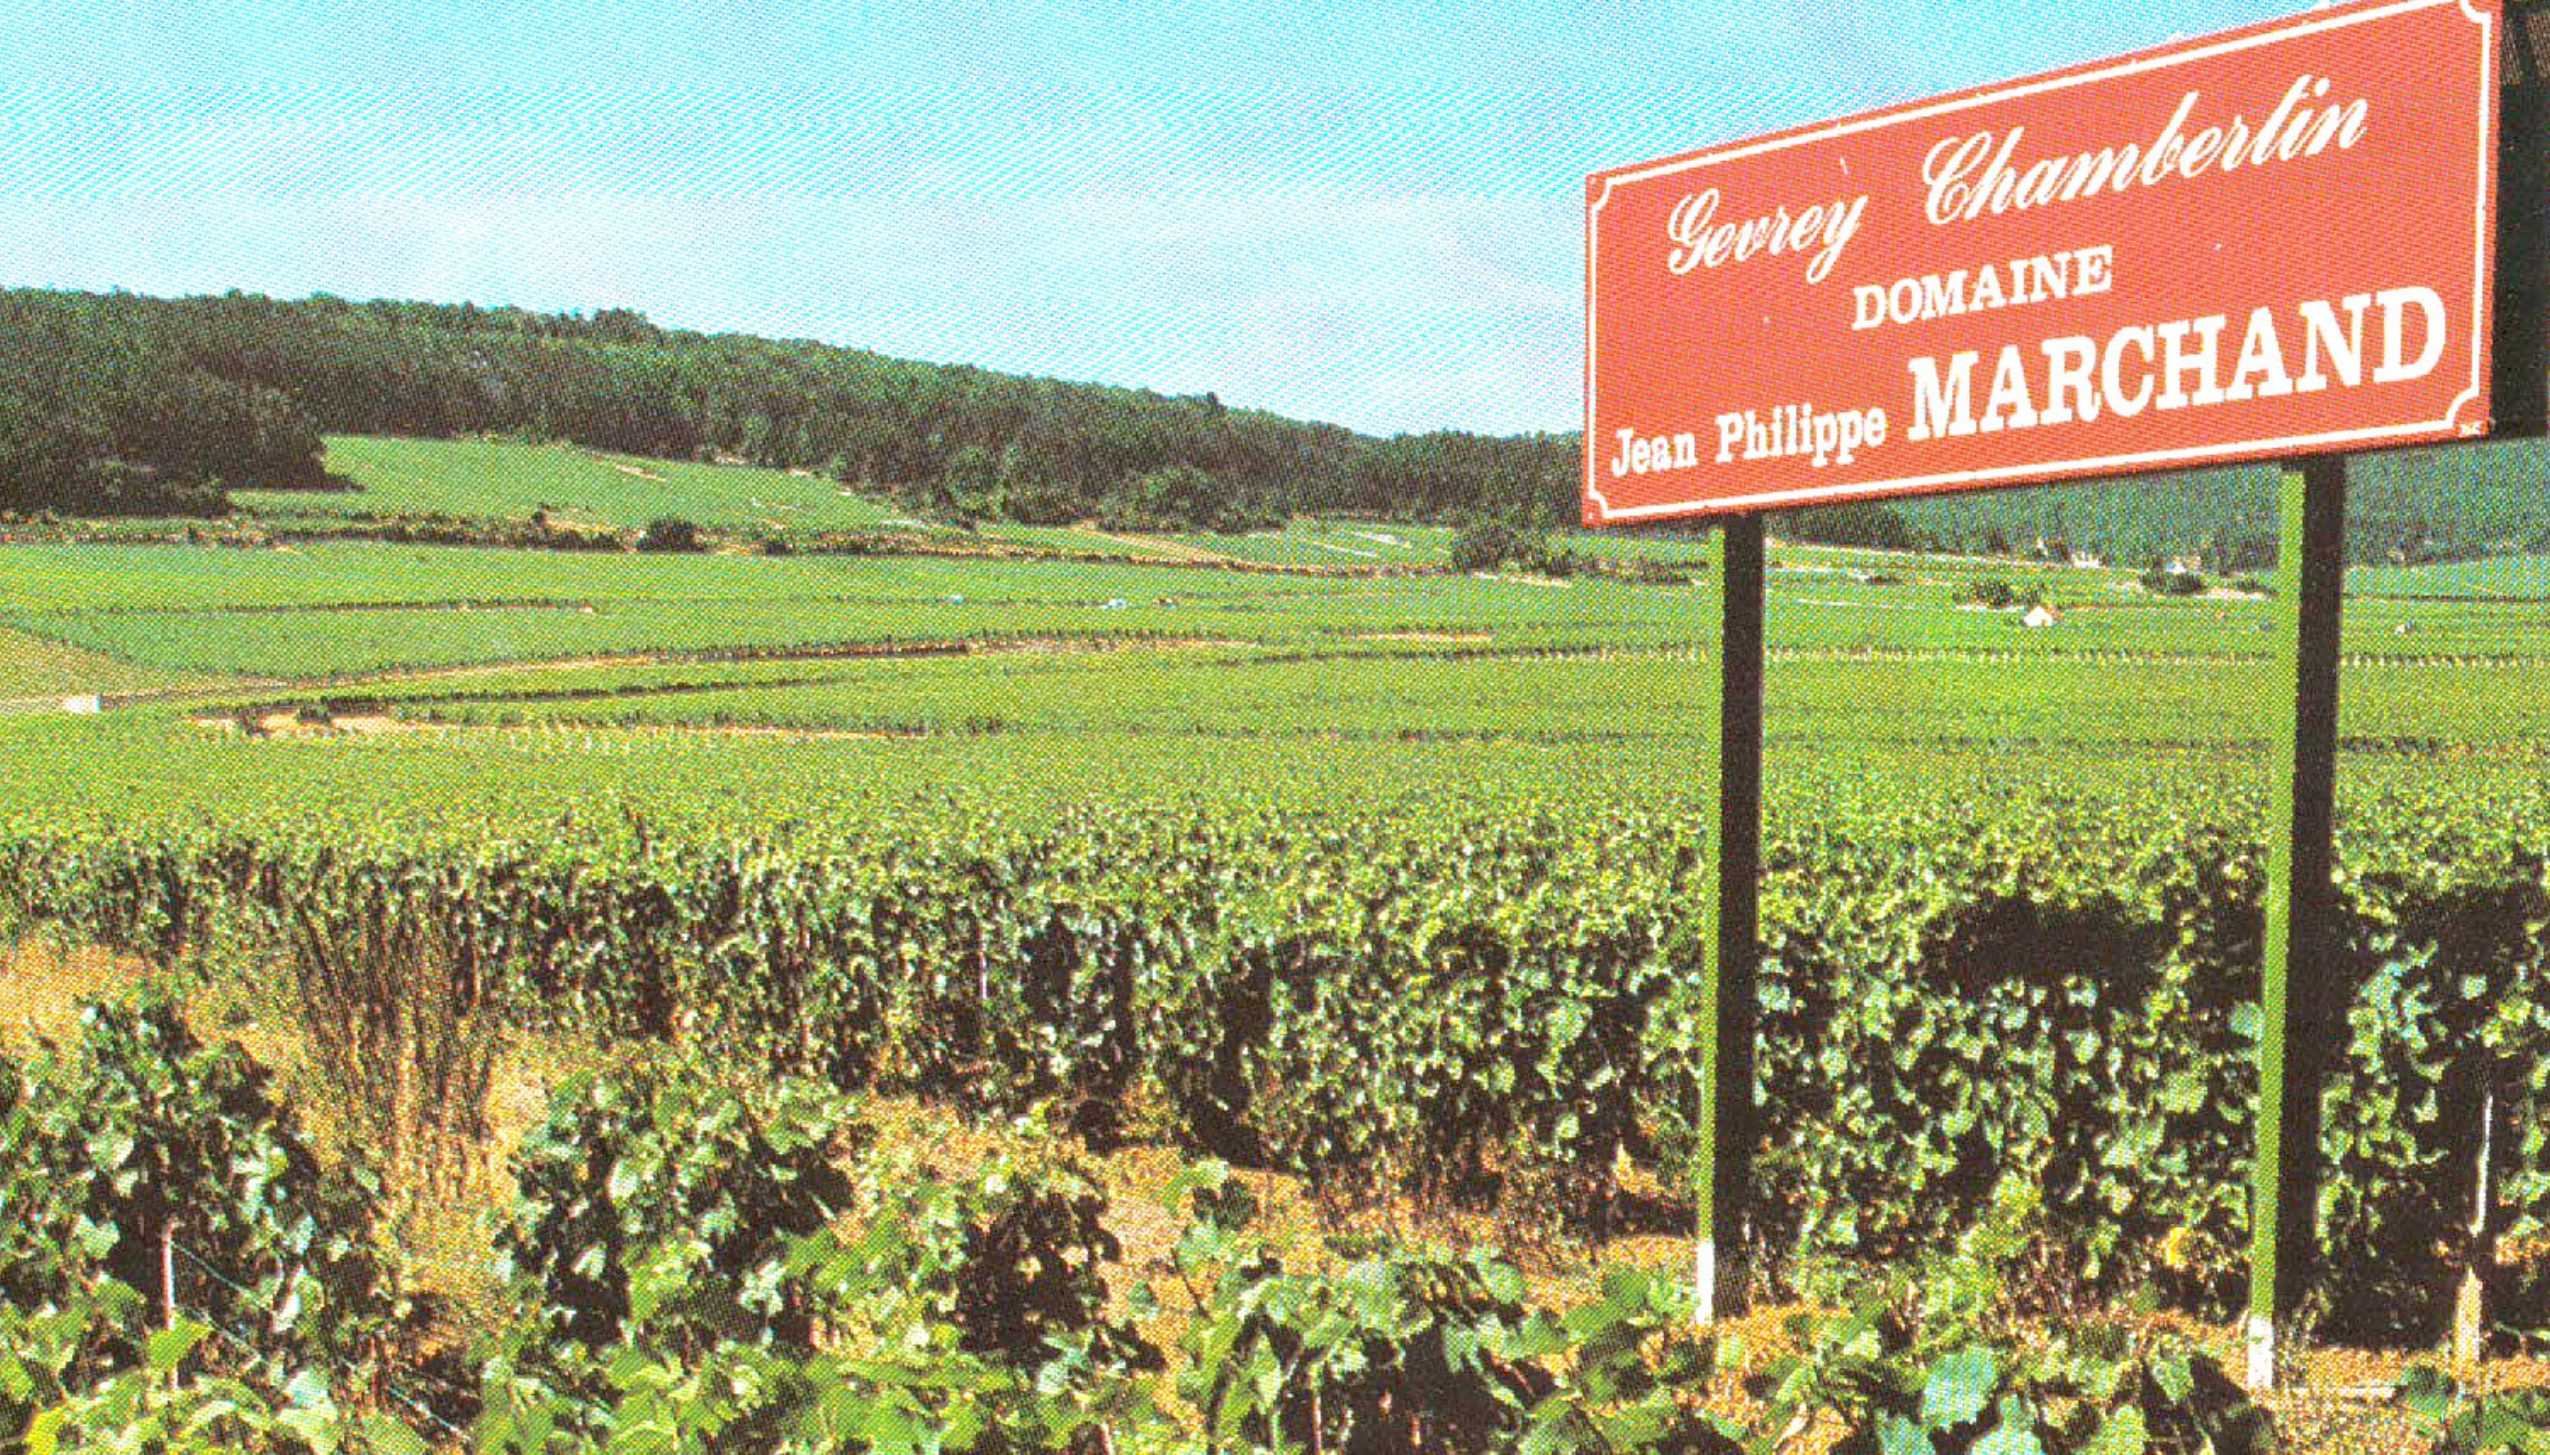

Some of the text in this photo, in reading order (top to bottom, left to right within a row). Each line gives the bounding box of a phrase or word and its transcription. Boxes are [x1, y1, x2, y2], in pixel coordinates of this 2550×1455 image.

[1667, 188, 1869, 284] Gevrey
[1852, 245, 2113, 331] DOMAINE
[1611, 285, 2448, 478] Jean Philippe MARCHAND
